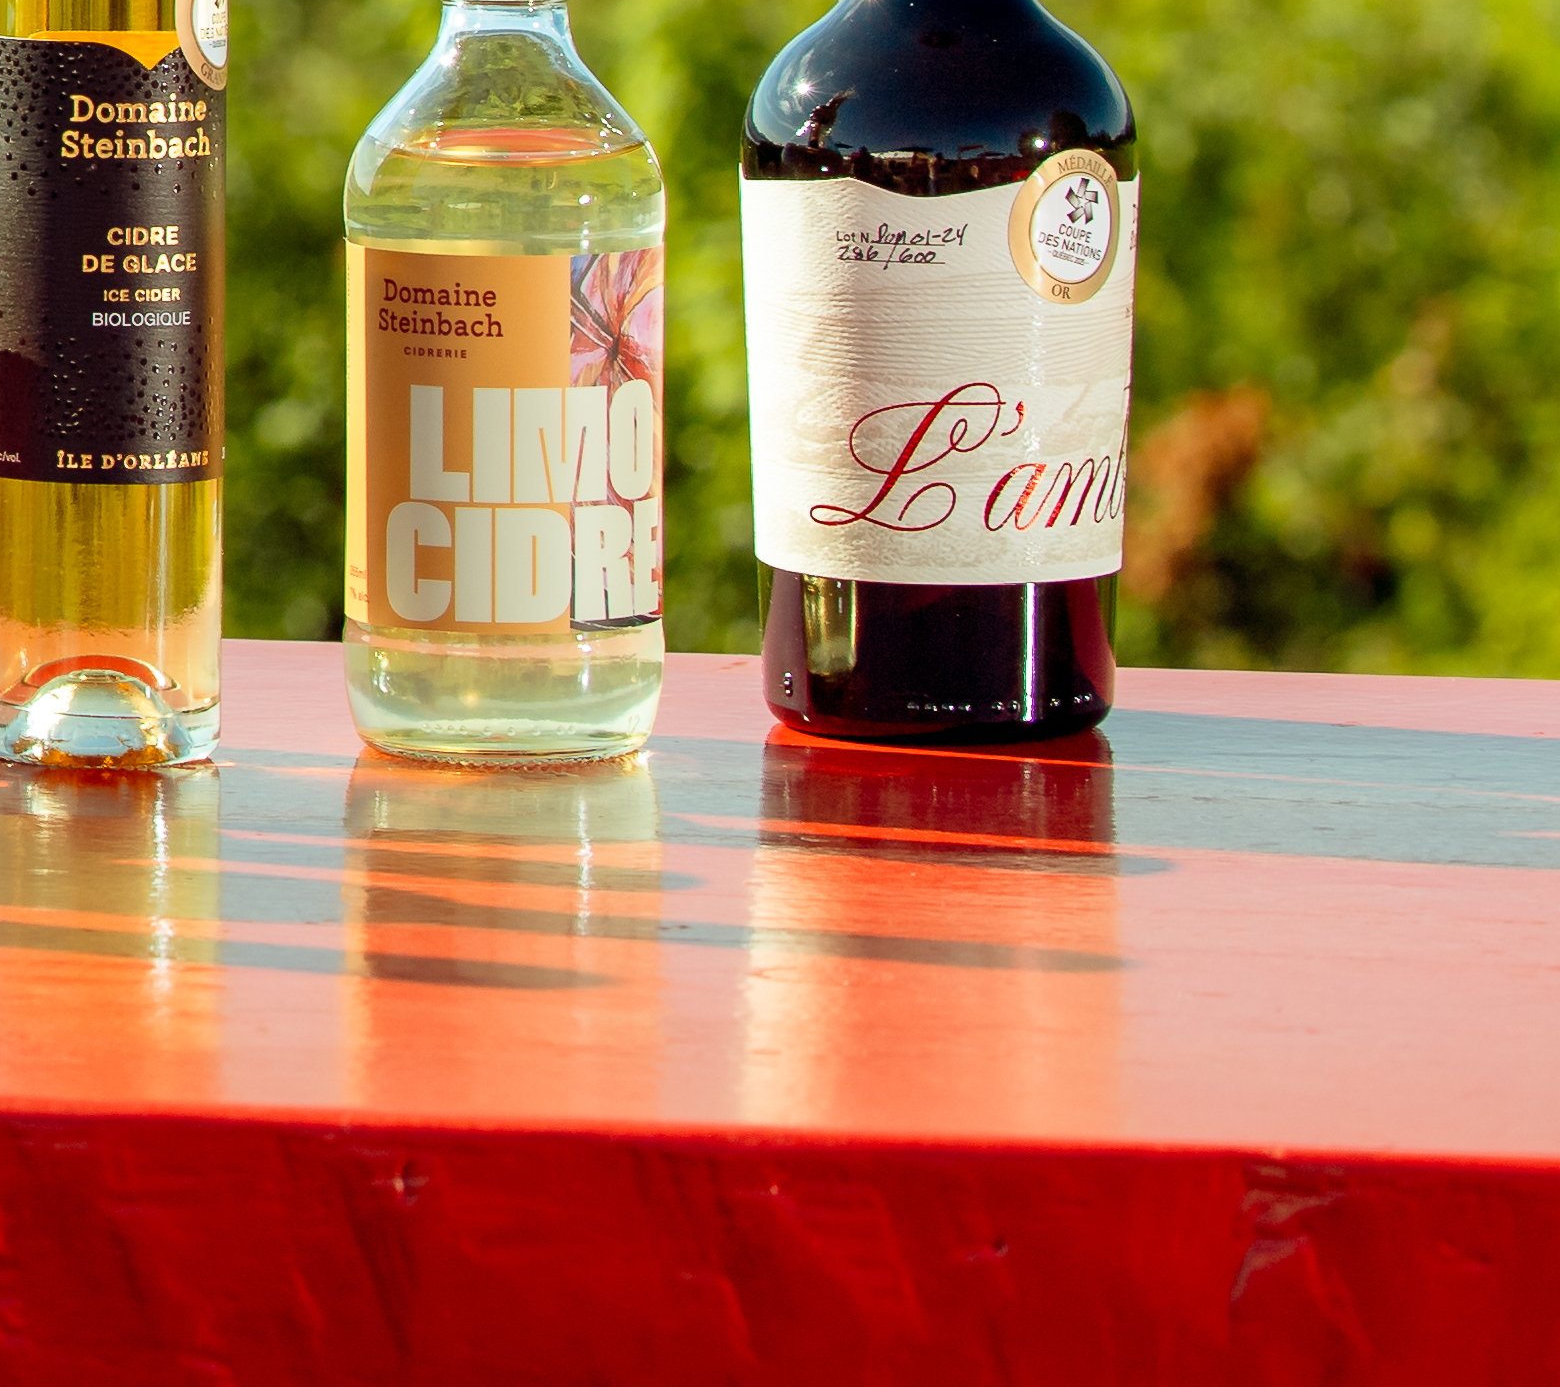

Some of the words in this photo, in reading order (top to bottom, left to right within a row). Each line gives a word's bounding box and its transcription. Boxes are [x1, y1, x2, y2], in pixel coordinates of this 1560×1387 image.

[70, 93, 207, 123] Domaine
[61, 128, 211, 159] Steinbach
[1058, 155, 1114, 188] MÉDAILLE
[108, 227, 179, 246] CIDRE
[1058, 224, 1092, 243] COUPE
[1038, 232, 1059, 247] DES
[1062, 239, 1102, 261] NATIONS
[82, 255, 114, 273] DE
[123, 253, 196, 273] GLACE
[104, 290, 129, 302] ICE
[135, 289, 180, 301] CIDER
[383, 279, 497, 307] Domaine
[1052, 284, 1071, 299] OR
[92, 312, 190, 326] BIOLOGIQUE
[378, 309, 503, 337] Steinbach
[404, 346, 467, 359] CIDRERIE
[410, 379, 653, 503] LIMO
[57, 451, 92, 469] ÎLE
[101, 450, 208, 469] D'ORLÉANS
[386, 496, 658, 623] CIDRE
